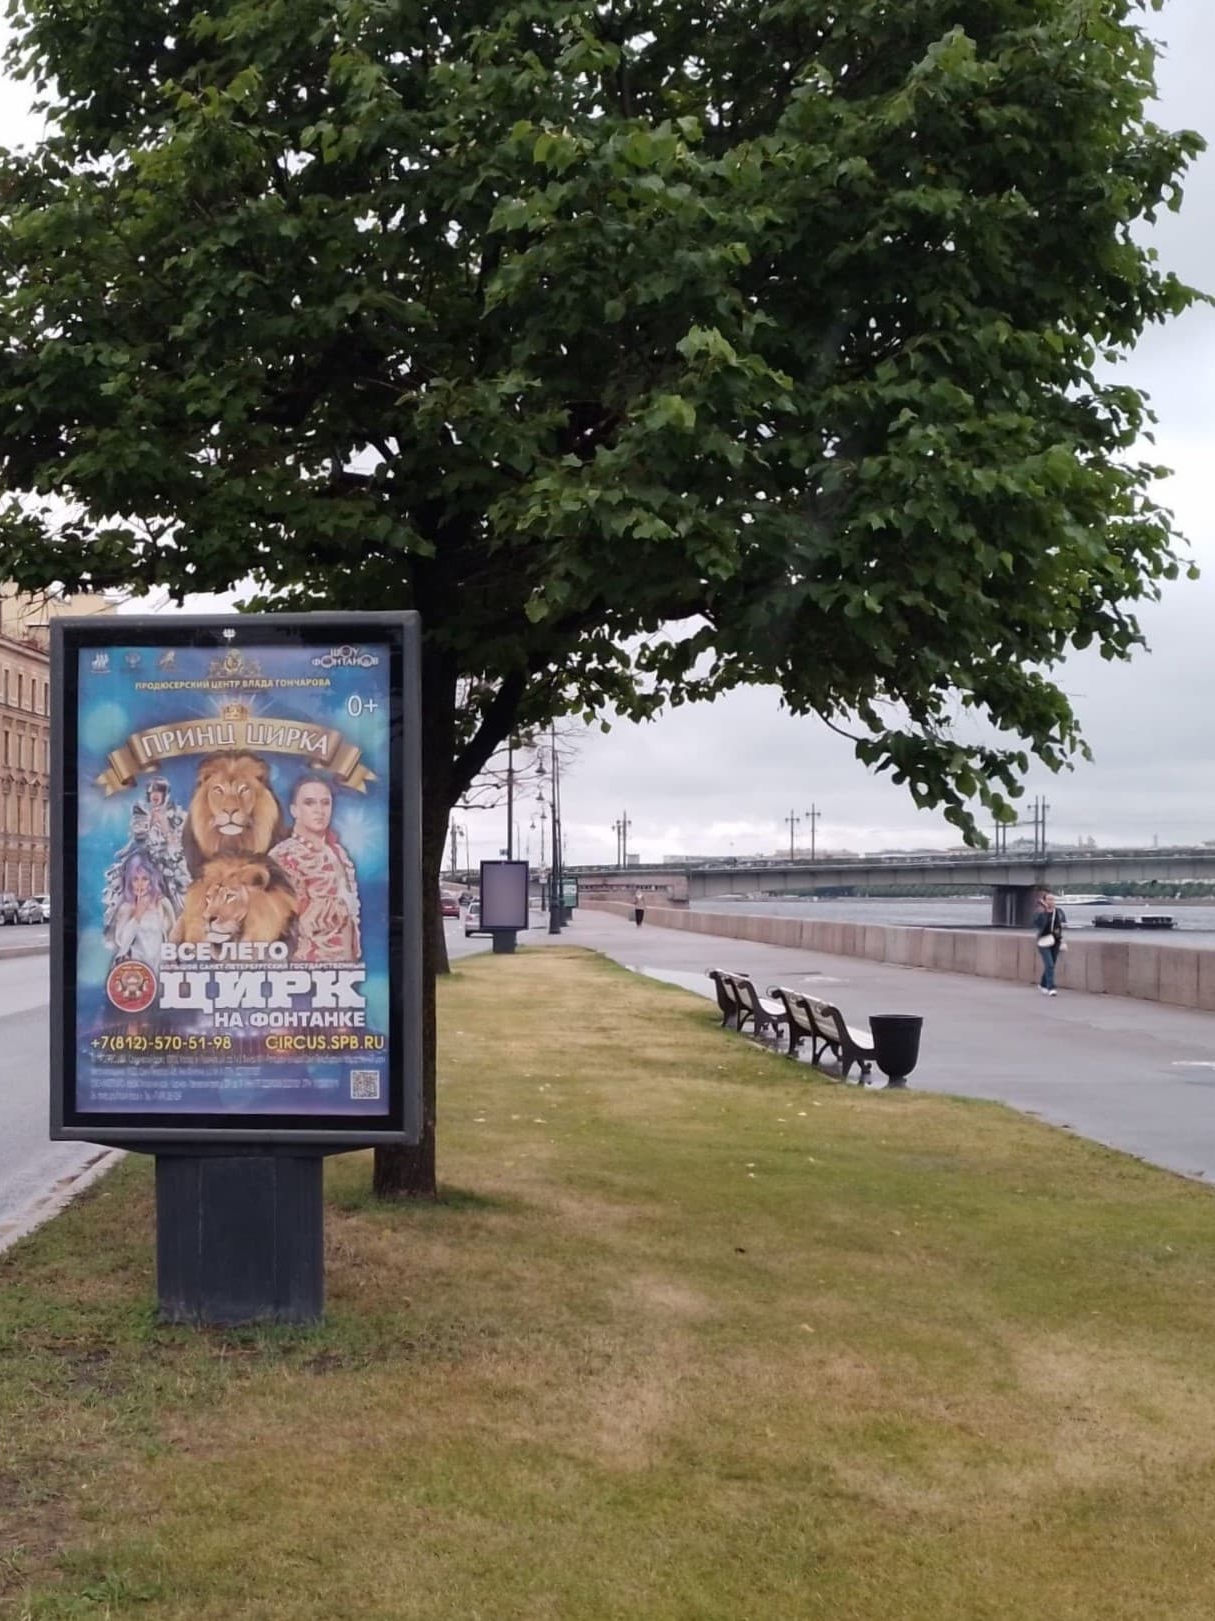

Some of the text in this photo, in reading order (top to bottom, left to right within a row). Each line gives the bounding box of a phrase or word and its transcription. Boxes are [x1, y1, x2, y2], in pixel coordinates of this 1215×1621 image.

[330, 645, 359, 658] ШОУ
[312, 654, 379, 668] ФОНТАНОВ
[135, 678, 331, 690] ПРОДЮСЕРСКИЙ ЦЕНТР ВЛАДА ГОНЧАРОВА
[347, 694, 378, 717] 0+
[141, 723, 329, 757] ПРИНЦ ЦИРКА
[160, 941, 288, 961] ВСЕ ЛЕТО
[159, 970, 365, 1014] ЦИРК
[215, 1011, 365, 1028] НА ФОНТАНКЕ
[91, 1036, 232, 1050] +7(812)-570-51-98
[265, 1035, 384, 1049] CIRCUS.SPB.RU
